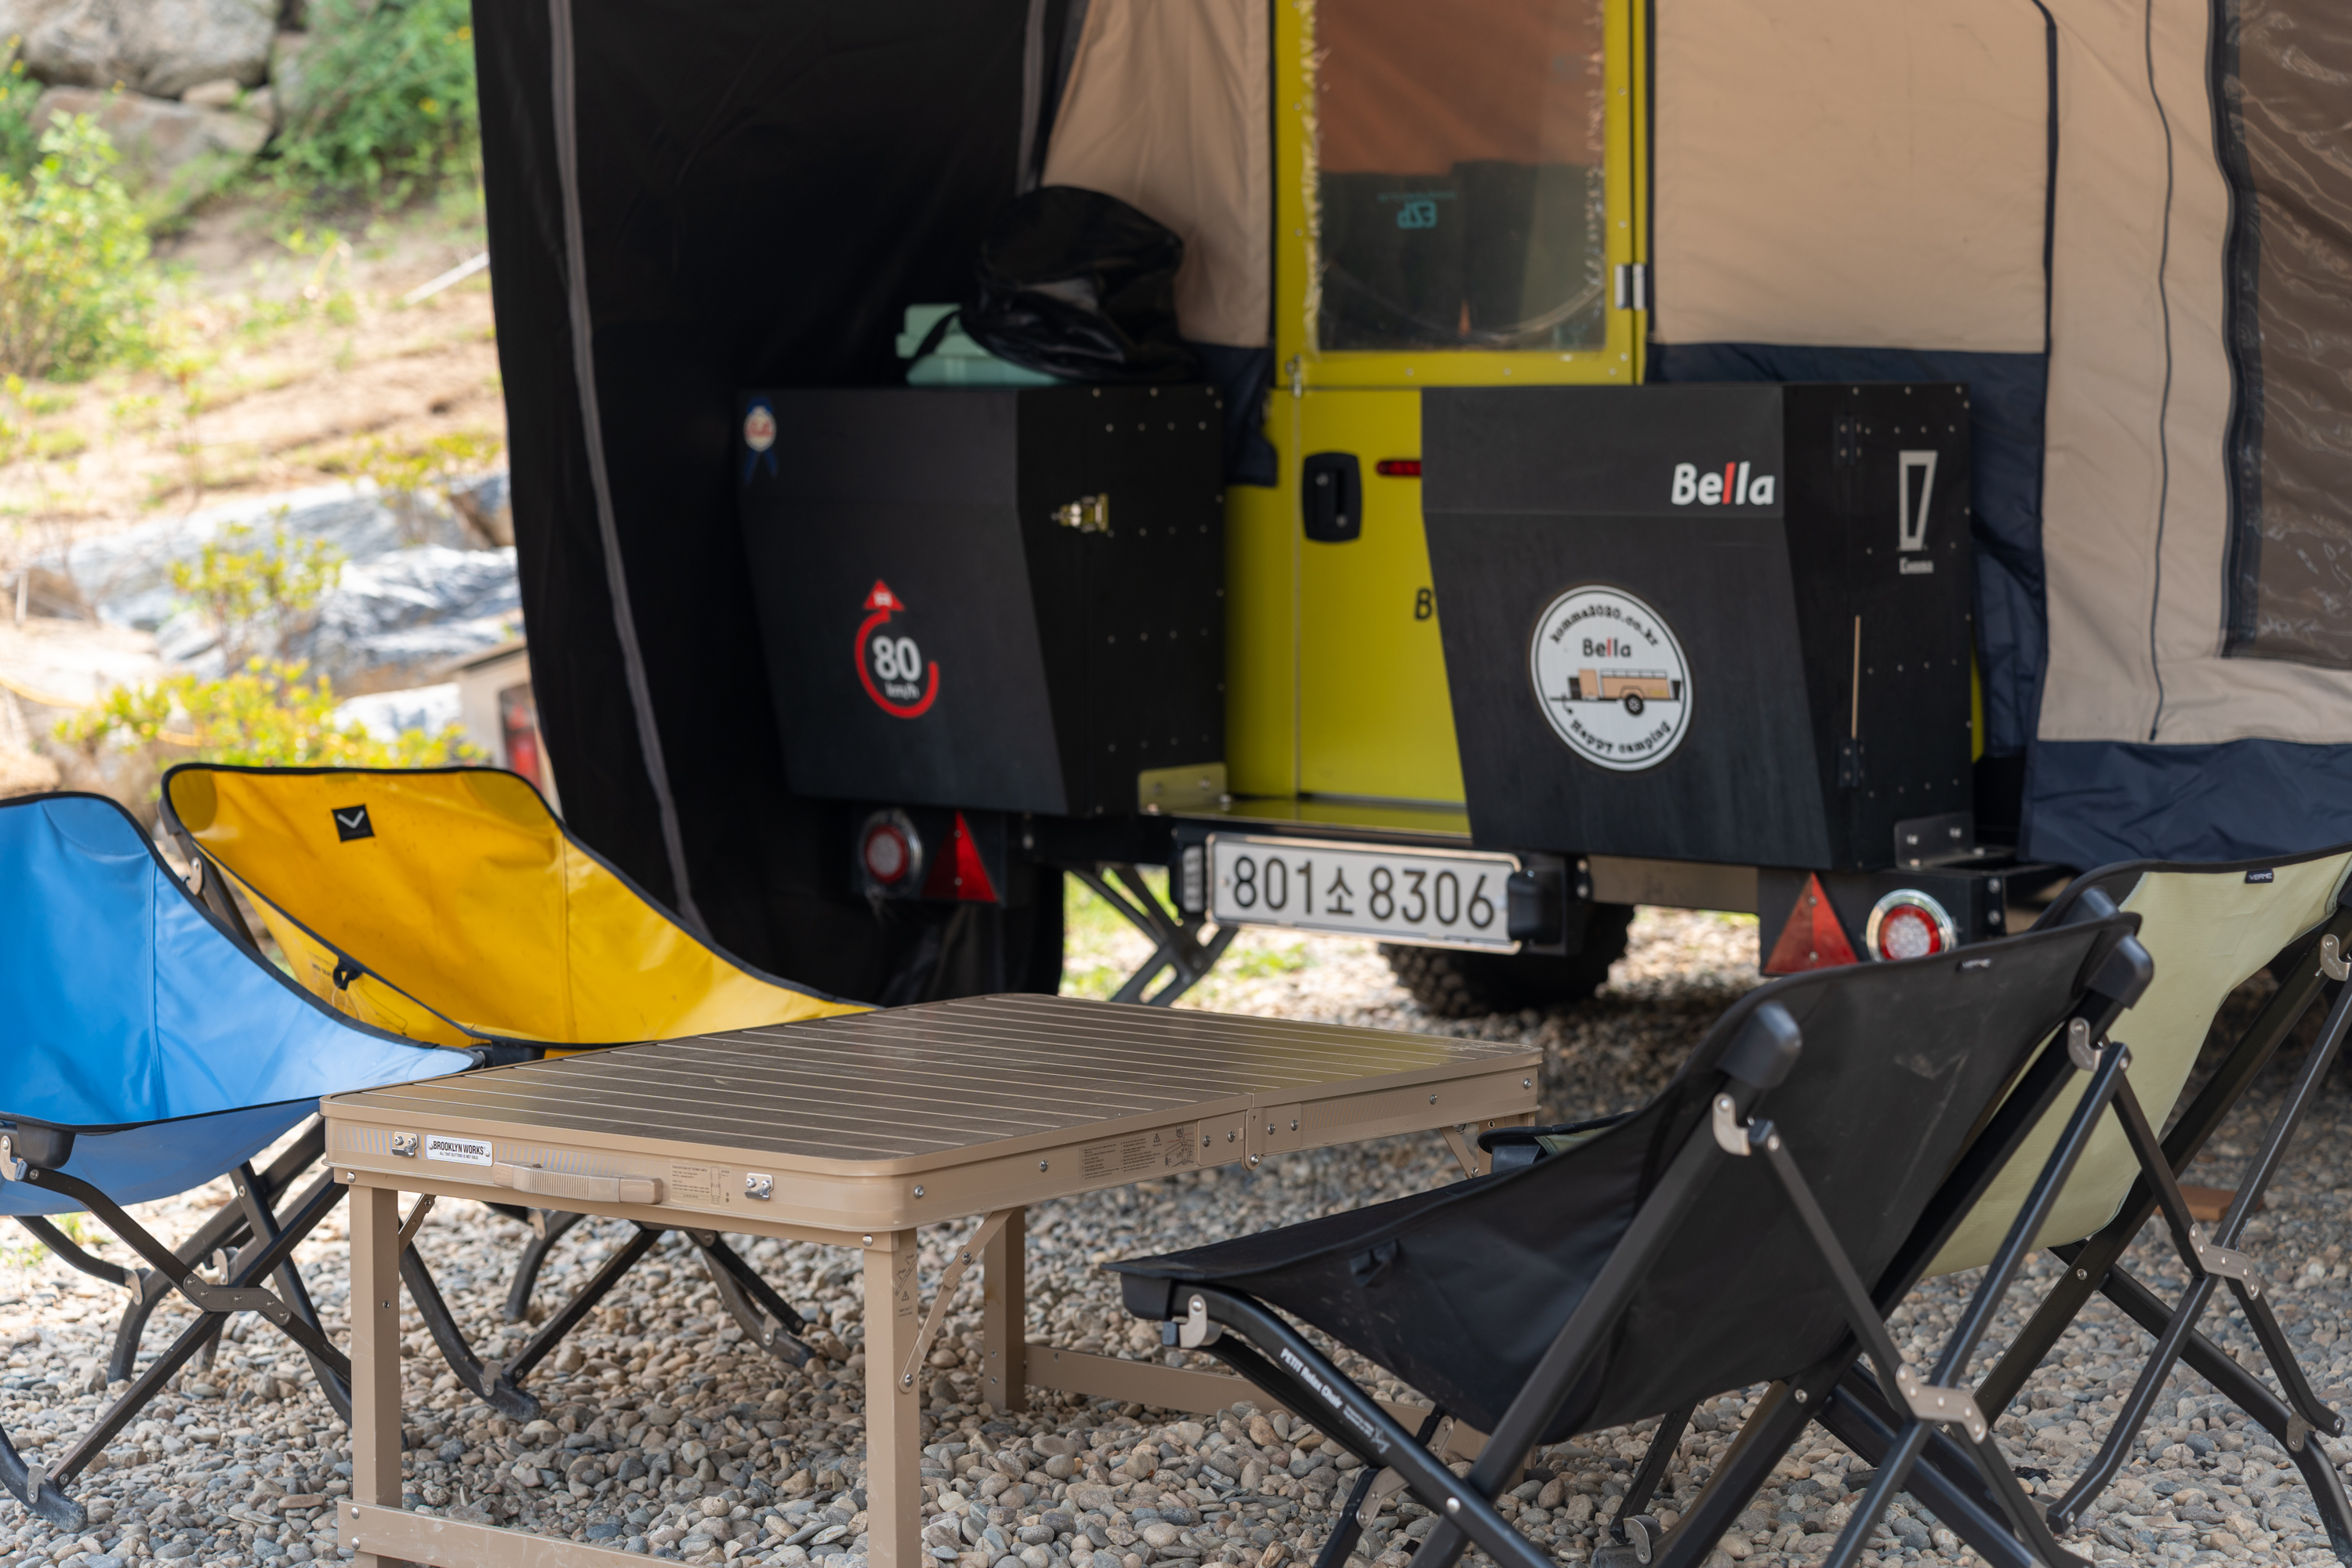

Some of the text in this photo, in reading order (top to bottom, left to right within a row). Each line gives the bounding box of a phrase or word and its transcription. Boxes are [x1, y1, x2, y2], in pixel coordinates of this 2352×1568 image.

[1671, 461, 1775, 505] Bella
[872, 635, 922, 681] 80
[1582, 637, 1632, 658] Bella
[884, 682, 920, 700] km/h
[1570, 720, 1614, 753] Happy
[434, 1141, 484, 1155] BROOKLYN WORKS
[1279, 1347, 1343, 1409] PETIT Relax Chair
